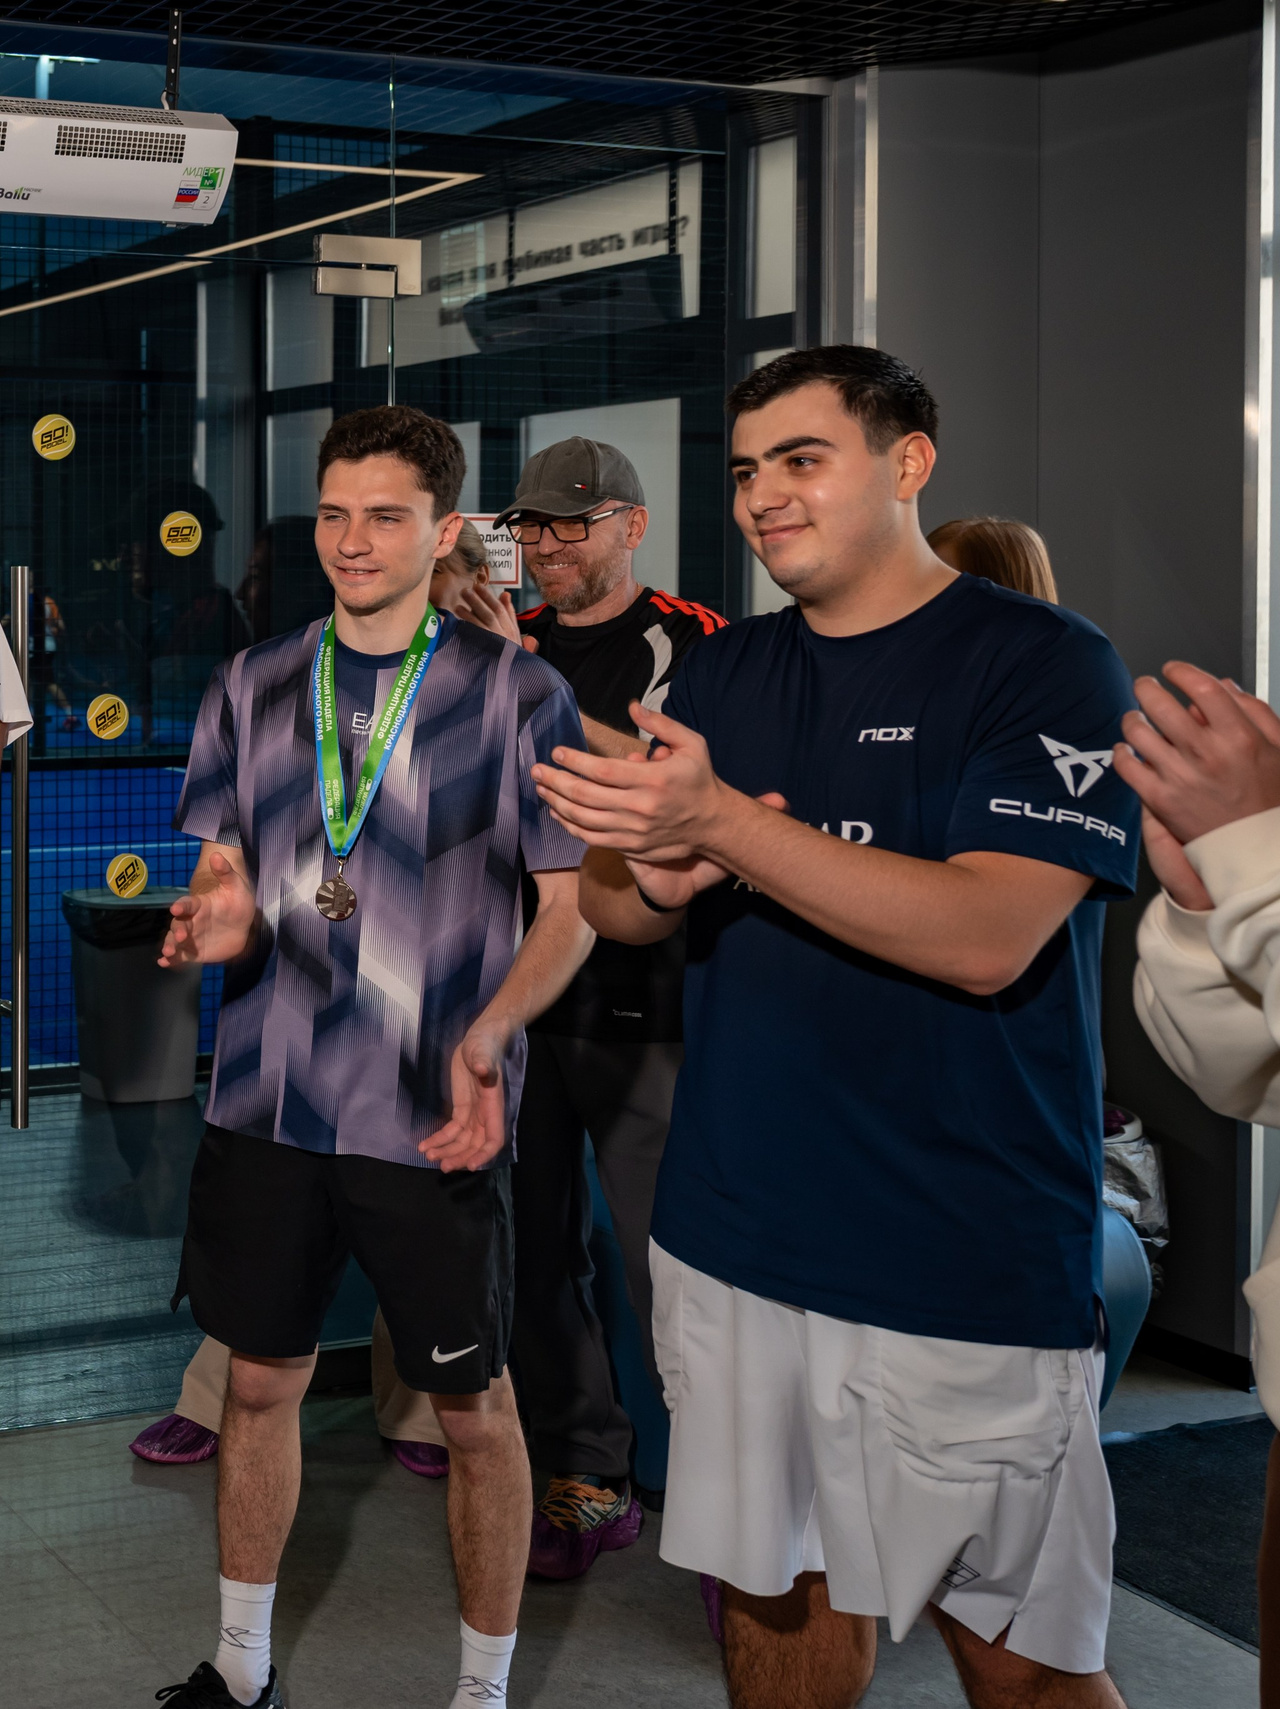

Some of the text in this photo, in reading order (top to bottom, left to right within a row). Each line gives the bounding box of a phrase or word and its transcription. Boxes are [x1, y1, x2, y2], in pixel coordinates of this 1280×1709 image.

[41, 425, 69, 444] GO!
[167, 525, 197, 537] GO!
[479, 534, 512, 543] ОДИТЬ
[314, 642, 325, 717] КРАСНОДАРСКОГО
[323, 645, 333, 732] ФЕДЕРАЦИЯ ПАДЕЛА
[377, 653, 418, 739] ФЕДЕРАЦИЯ ПАДЕЛА
[95, 701, 121, 728] GO!
[384, 651, 430, 751] КРАСНОДАРСКОГО КРАЯ
[989, 798, 1127, 847] CUPRA
[114, 858, 140, 889] GO!
